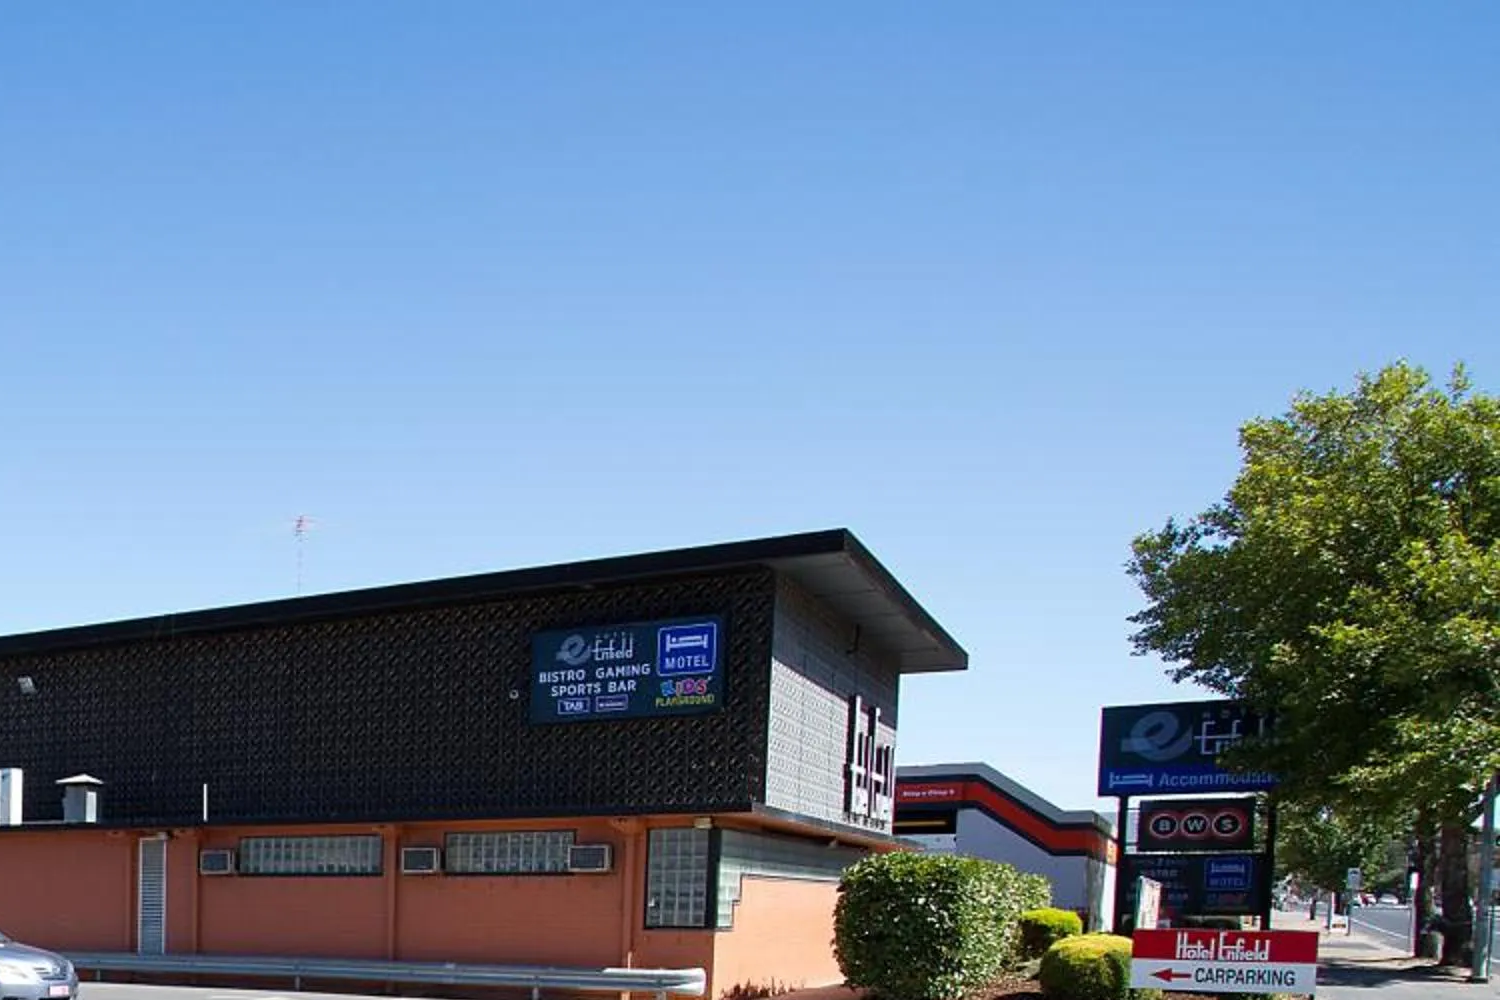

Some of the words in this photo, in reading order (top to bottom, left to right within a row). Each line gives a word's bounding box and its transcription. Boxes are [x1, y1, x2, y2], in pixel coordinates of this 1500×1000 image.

[664, 655, 710, 669] MOTEL
[539, 669, 586, 683] BISTRO
[595, 663, 651, 680] GAMING
[550, 681, 602, 697] SPORTS
[607, 679, 637, 693] BAR
[563, 700, 584, 712] TAB
[1175, 931, 1215, 960] Hotel
[1217, 931, 1271, 961] Enfield
[1195, 967, 1296, 987] CARPARKING
